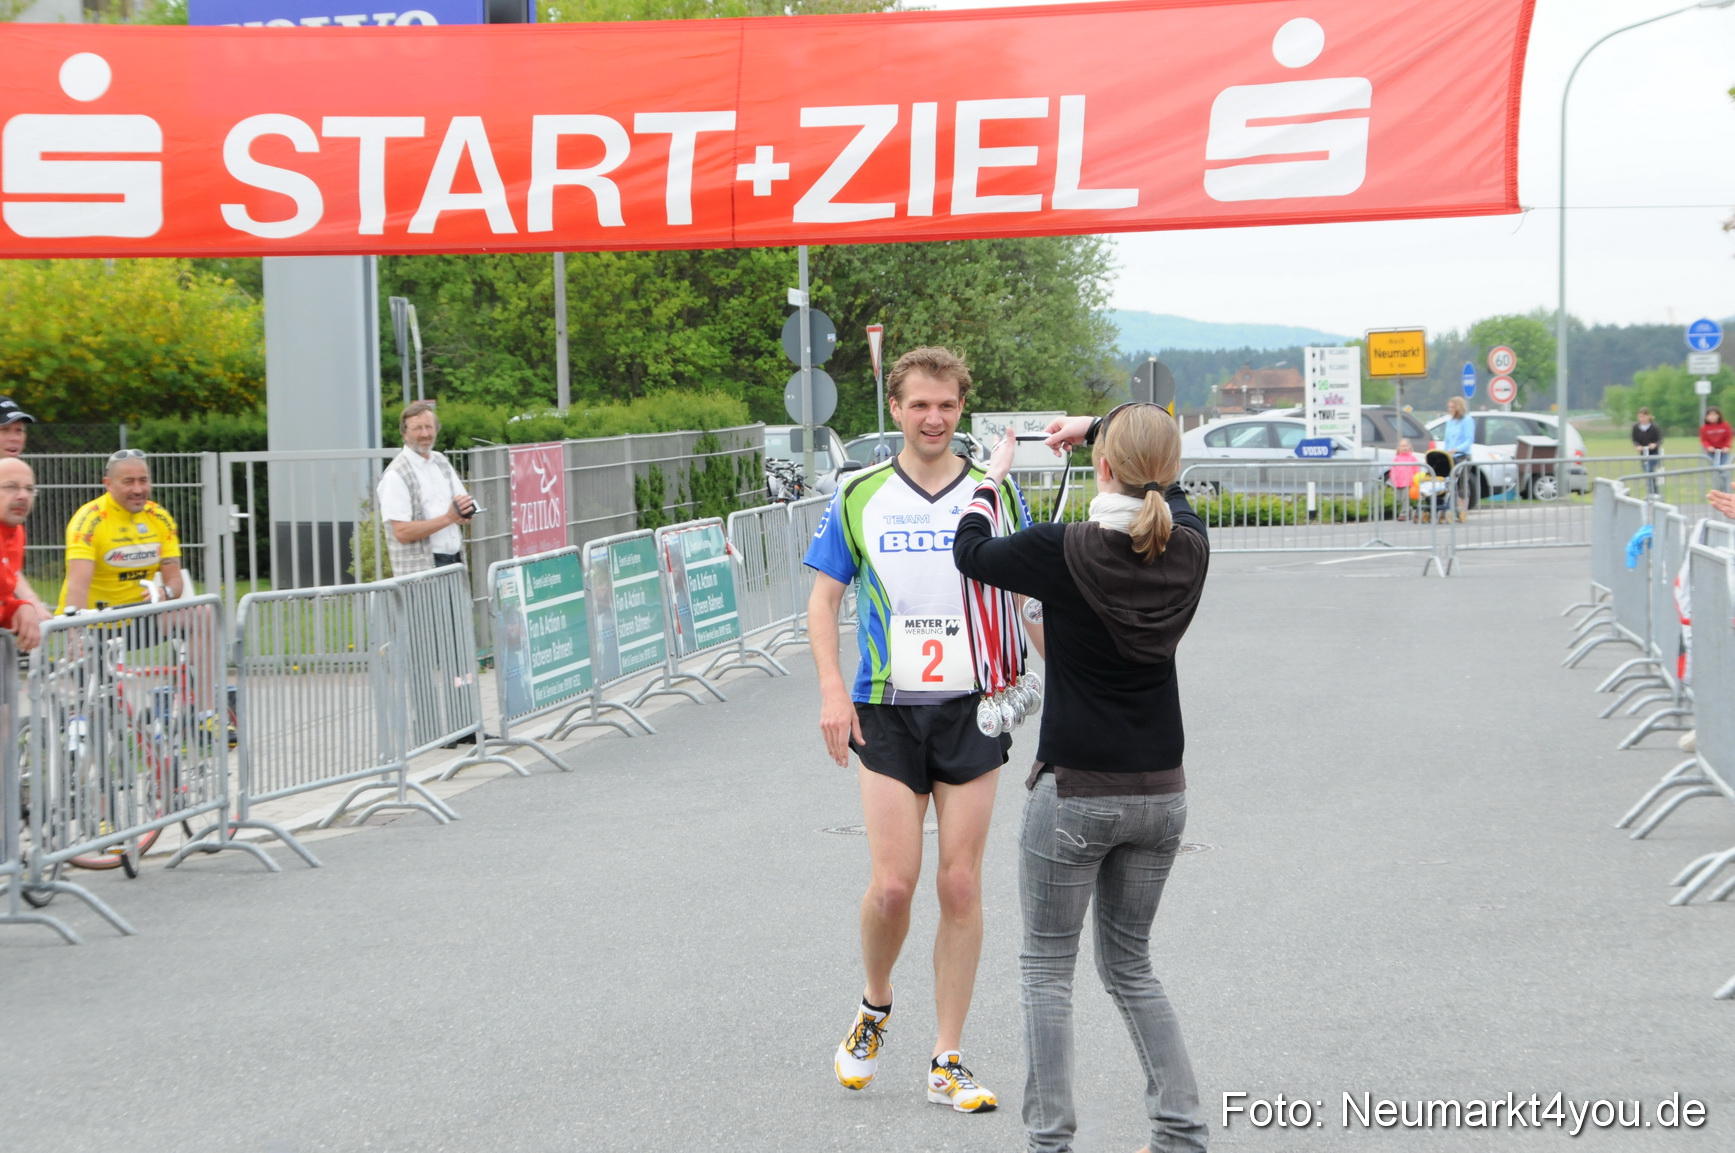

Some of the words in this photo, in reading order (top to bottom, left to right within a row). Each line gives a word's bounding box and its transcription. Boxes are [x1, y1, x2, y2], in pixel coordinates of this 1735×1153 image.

[1374, 346, 1420, 359] Neumarkt
[1495, 354, 1510, 367] 60
[1302, 446, 1329, 457] VOLVO
[520, 497, 560, 534] ZEITLOS
[883, 513, 931, 525] TEAM
[905, 619, 943, 628] MEYER
[921, 639, 944, 682] 2
